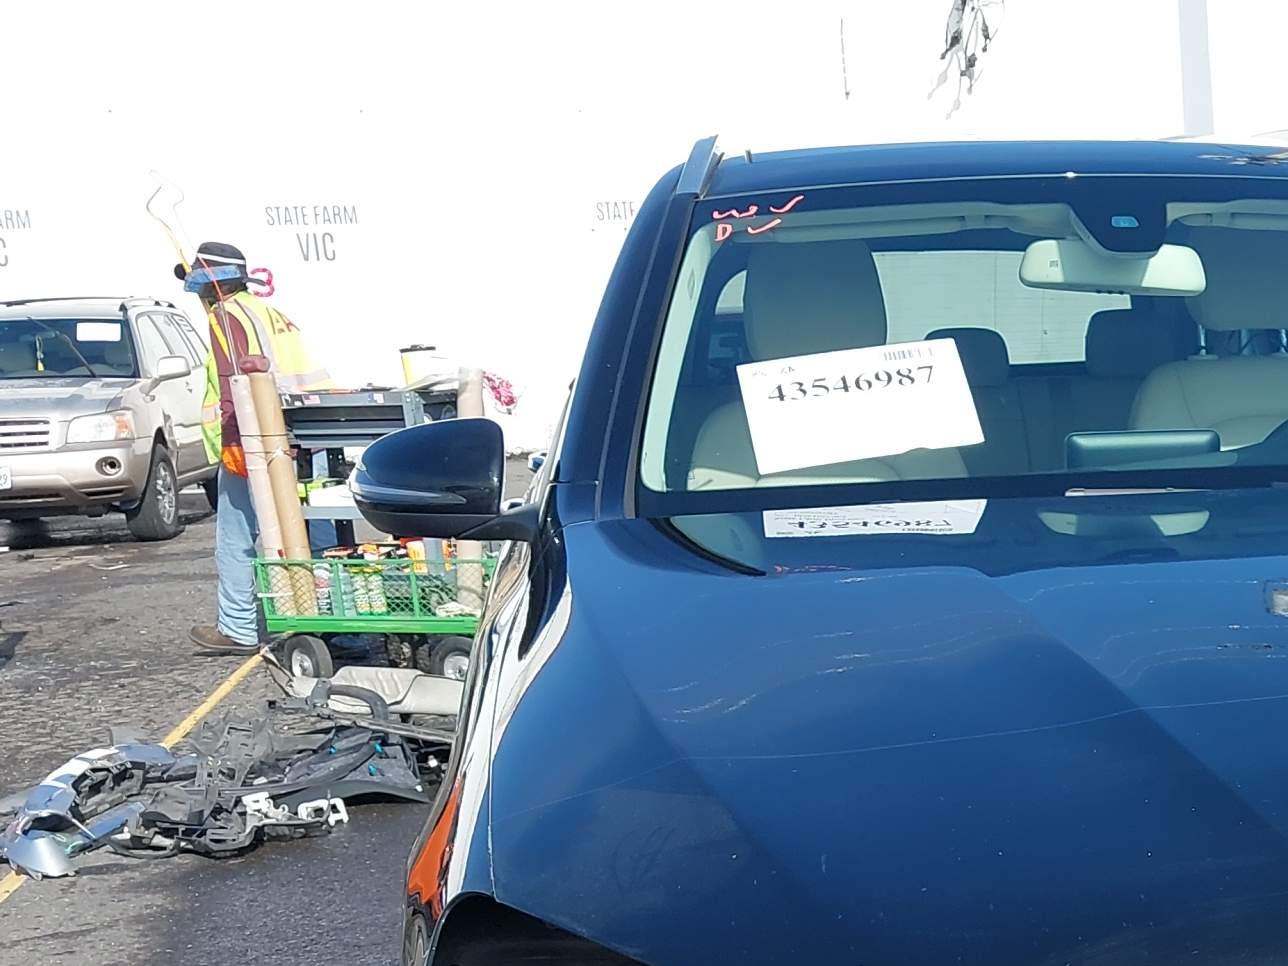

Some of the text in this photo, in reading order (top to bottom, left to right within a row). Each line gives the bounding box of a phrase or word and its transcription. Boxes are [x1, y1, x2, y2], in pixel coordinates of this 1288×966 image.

[265, 205, 358, 226] STATE FARM
[596, 201, 636, 221] STATE
[296, 232, 336, 262] VIC
[768, 365, 934, 401] 43546987
